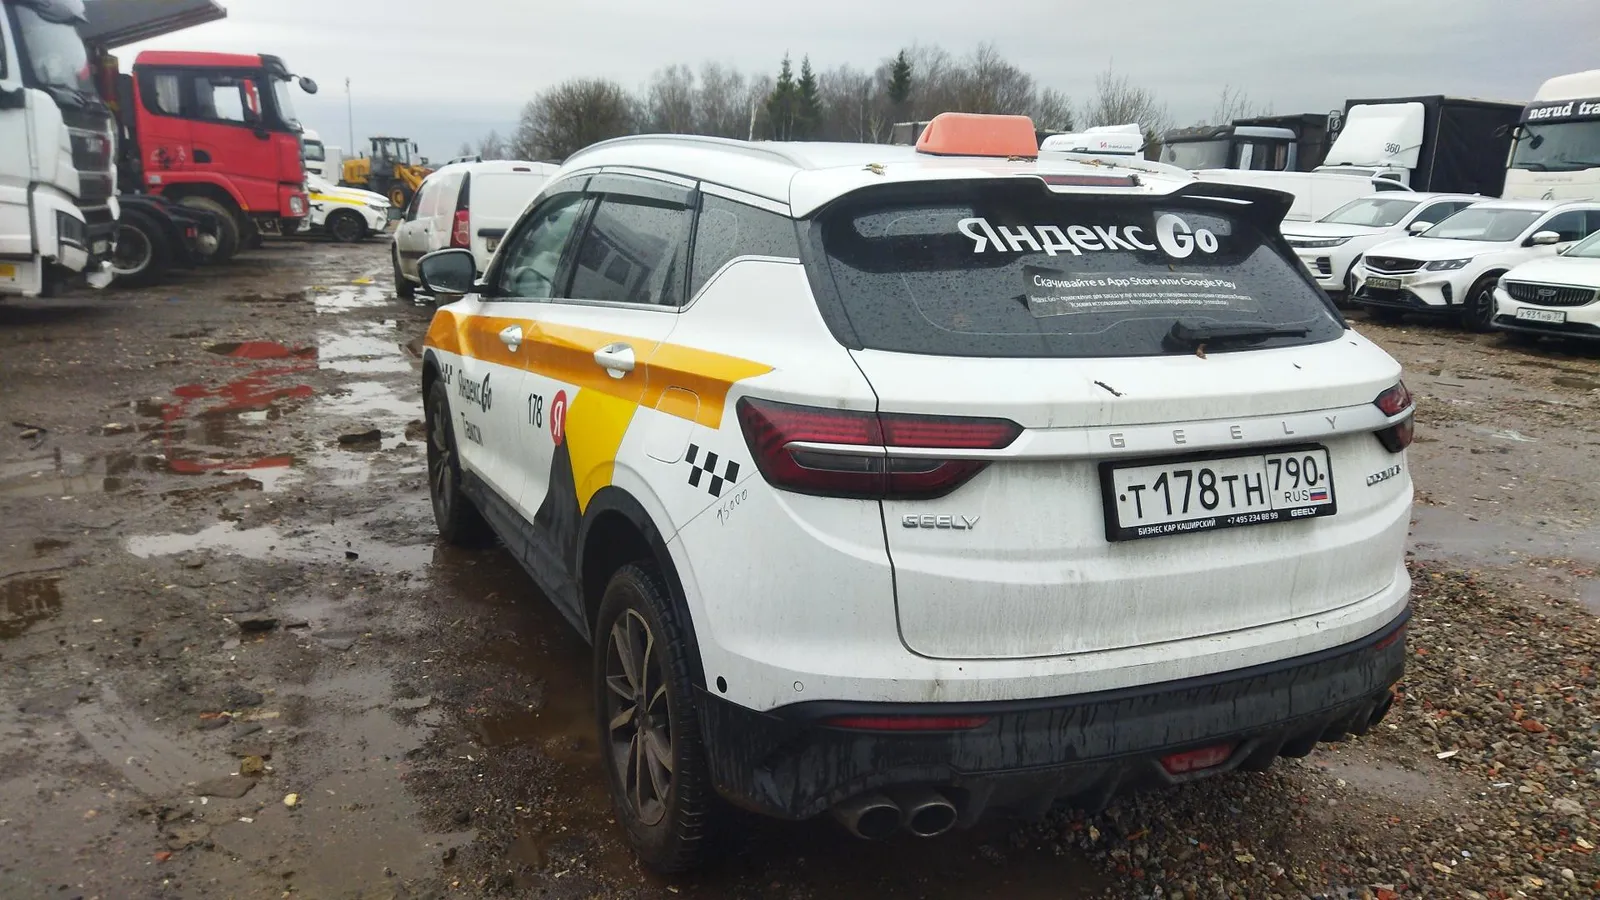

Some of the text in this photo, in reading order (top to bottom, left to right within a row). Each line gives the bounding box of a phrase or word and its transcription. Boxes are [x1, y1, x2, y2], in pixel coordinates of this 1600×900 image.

[1528, 102, 1575, 120] nerud
[1384, 142, 1401, 154] 360
[957, 213, 1219, 259] Яндекс Go
[1033, 275, 1097, 288] Скачивайте
[1106, 277, 1131, 287] App
[1130, 277, 1160, 286] Store
[1160, 277, 1180, 285] или
[1180, 277, 1215, 288] Google
[1214, 279, 1236, 290] Play
[458, 369, 492, 413] Яндекс Go
[528, 393, 543, 429] 178
[553, 401, 563, 437] Я
[460, 411, 484, 447] Такси
[1109, 416, 1337, 448] GEELY
[1268, 455, 1319, 491] 790
[1285, 489, 1309, 503] RUS
[1236, 515, 1247, 523] 495
[1248, 513, 1261, 521] 234
[1291, 508, 1317, 517] GEELY
[902, 514, 981, 530] GEELY
[1138, 519, 1216, 536] БИЗНЕС КАР КАШИРСКИЙ
